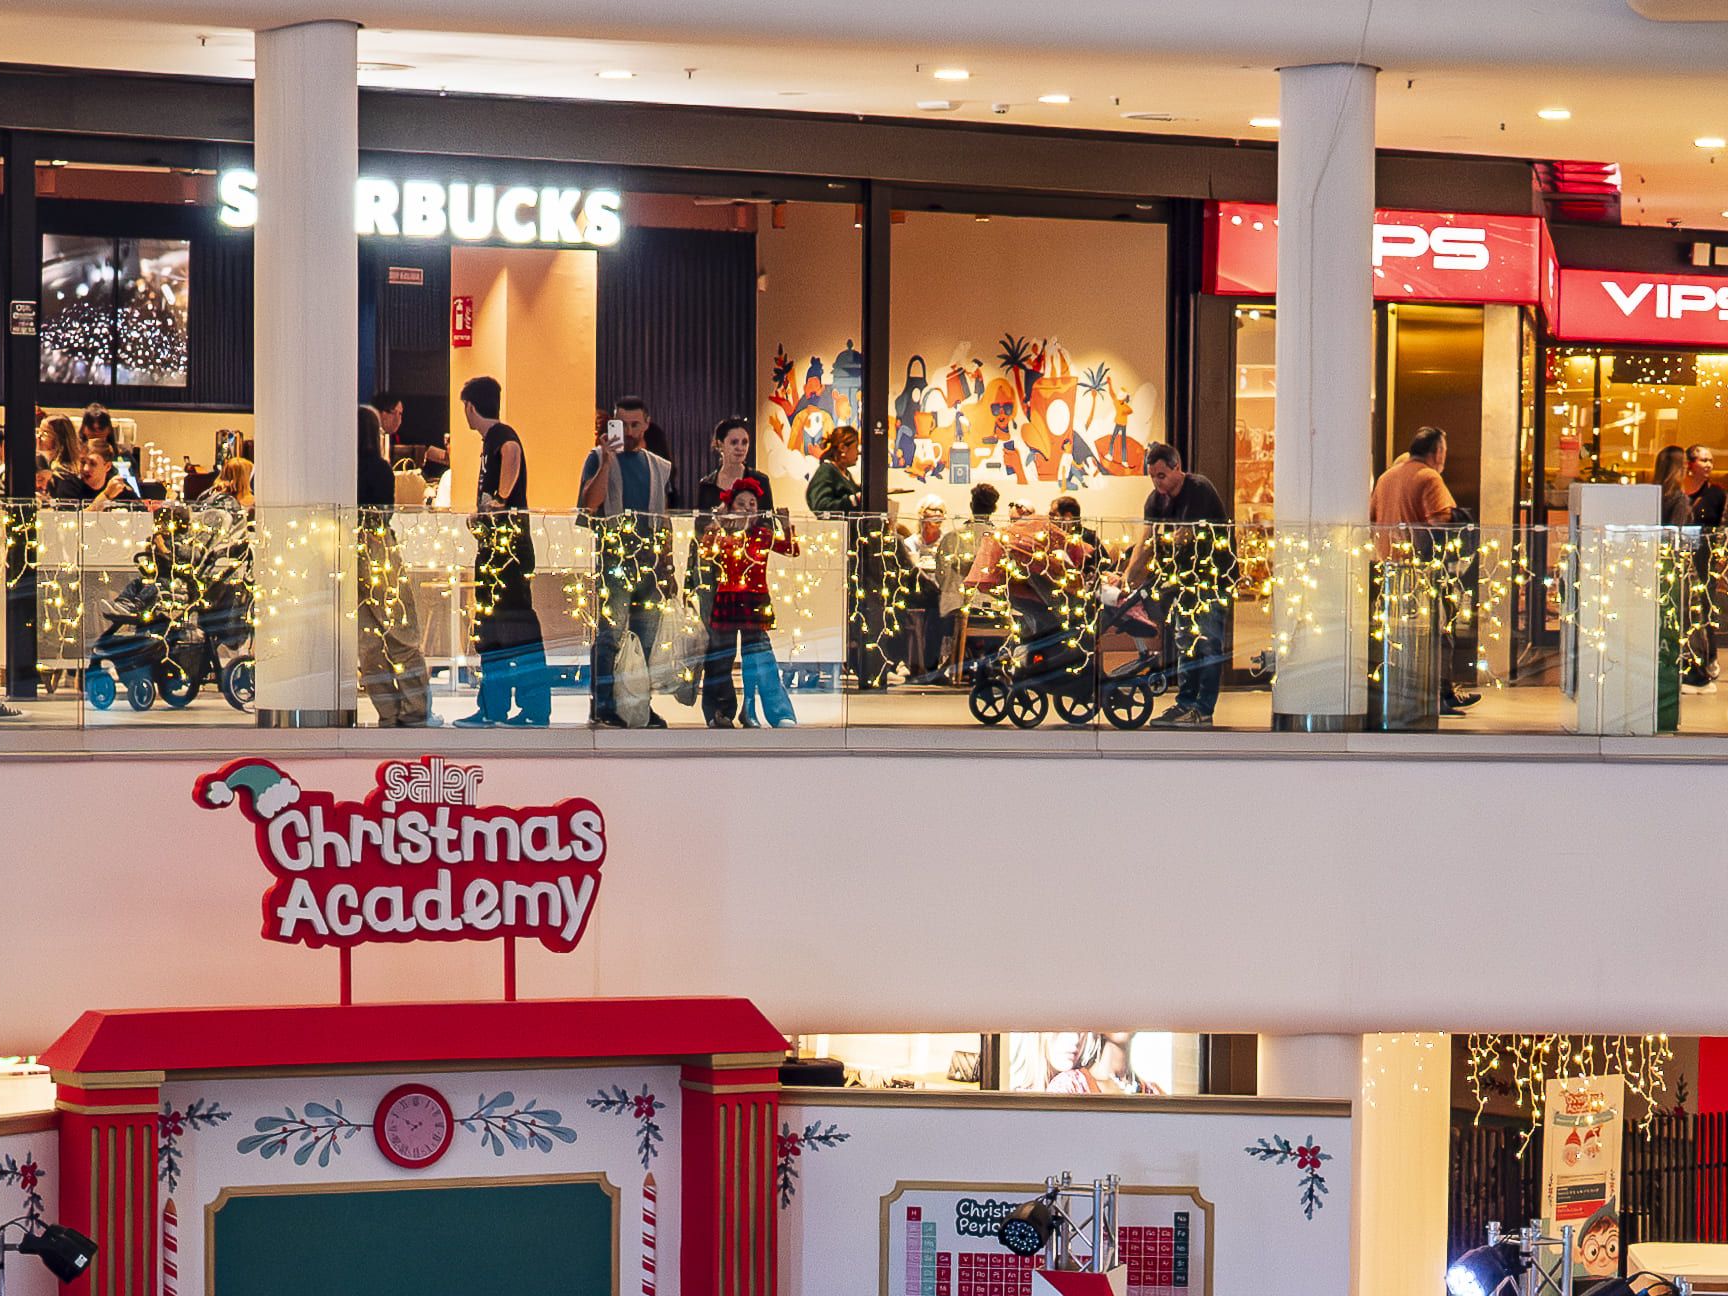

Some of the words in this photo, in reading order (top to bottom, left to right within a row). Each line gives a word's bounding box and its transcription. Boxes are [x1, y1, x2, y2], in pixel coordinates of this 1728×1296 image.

[219, 168, 622, 246] SRBUCKS
[1372, 224, 1490, 271] PS
[384, 758, 484, 805] saler
[268, 800, 604, 871] Christmas
[276, 869, 595, 942] Academy
